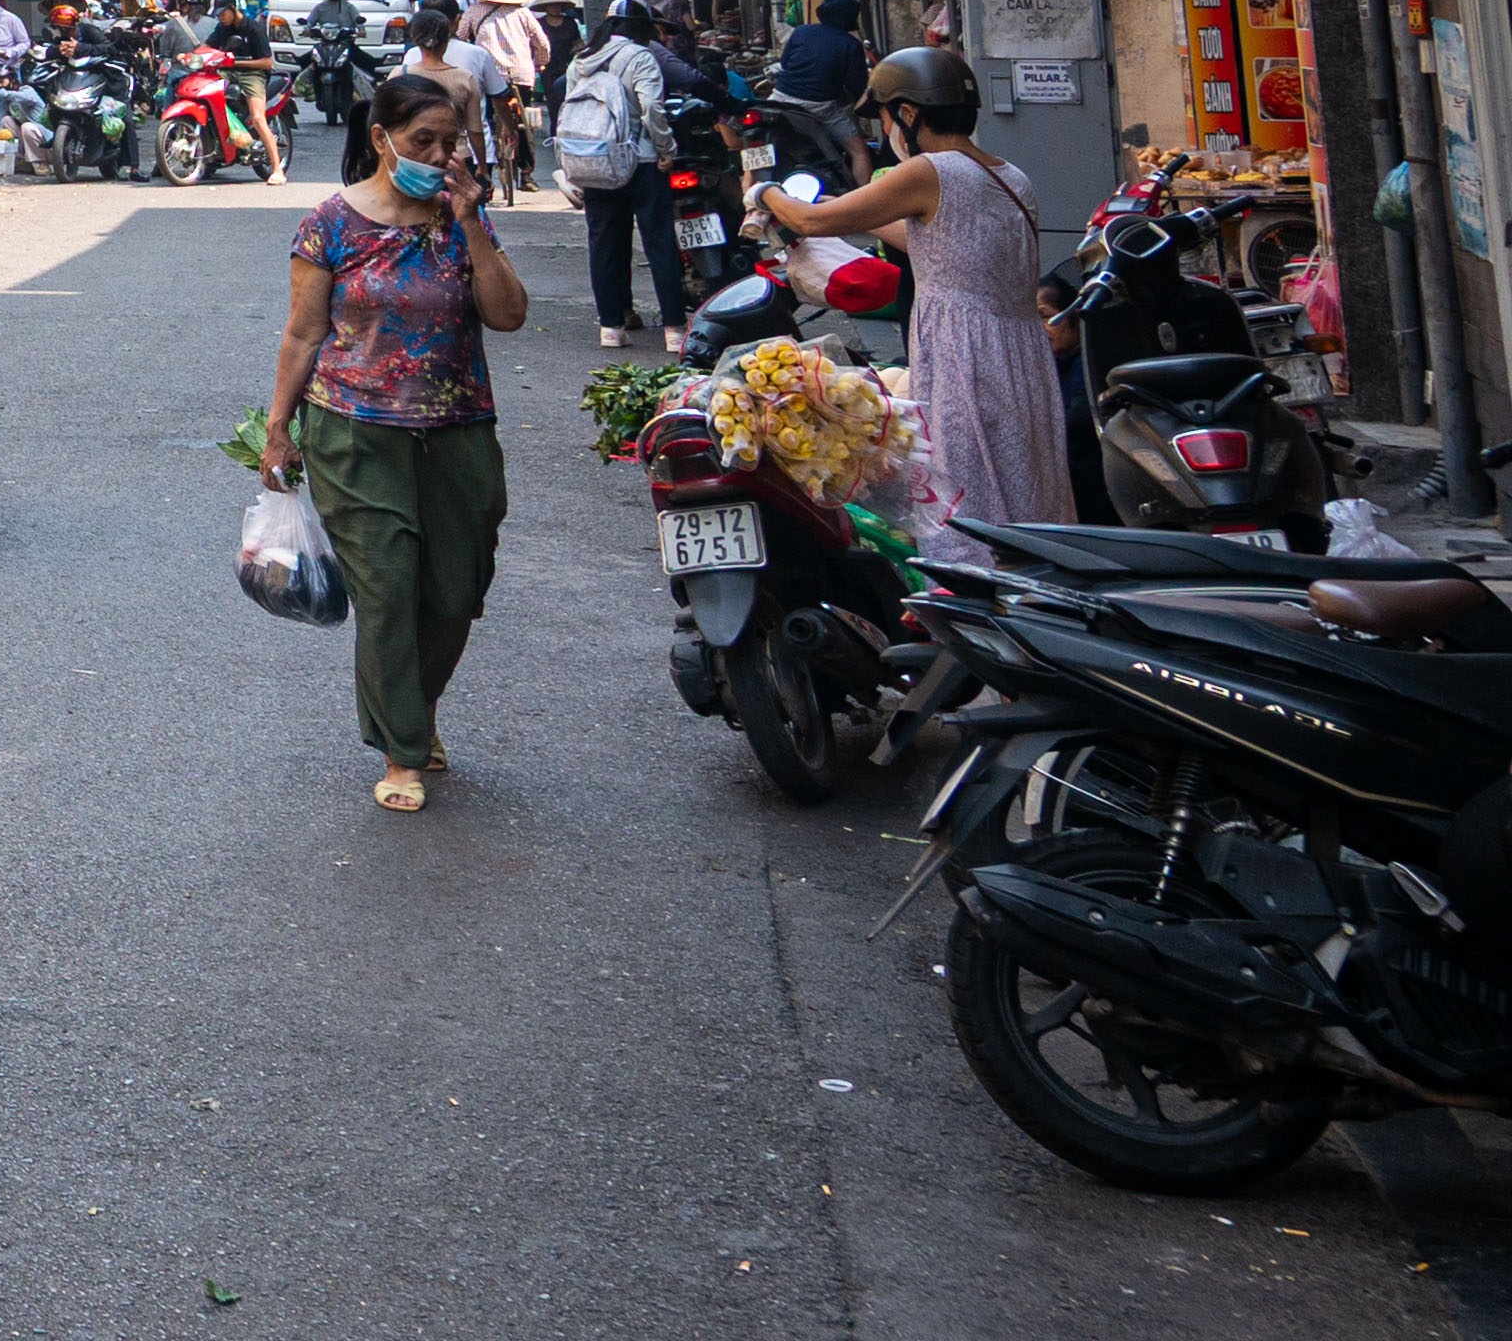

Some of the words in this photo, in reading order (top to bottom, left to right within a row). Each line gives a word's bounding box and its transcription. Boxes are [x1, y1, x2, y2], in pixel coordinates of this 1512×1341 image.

[1203, 74, 1233, 113] BÁNH
[673, 508, 747, 539] 29-T2
[675, 535, 747, 566] 6751
